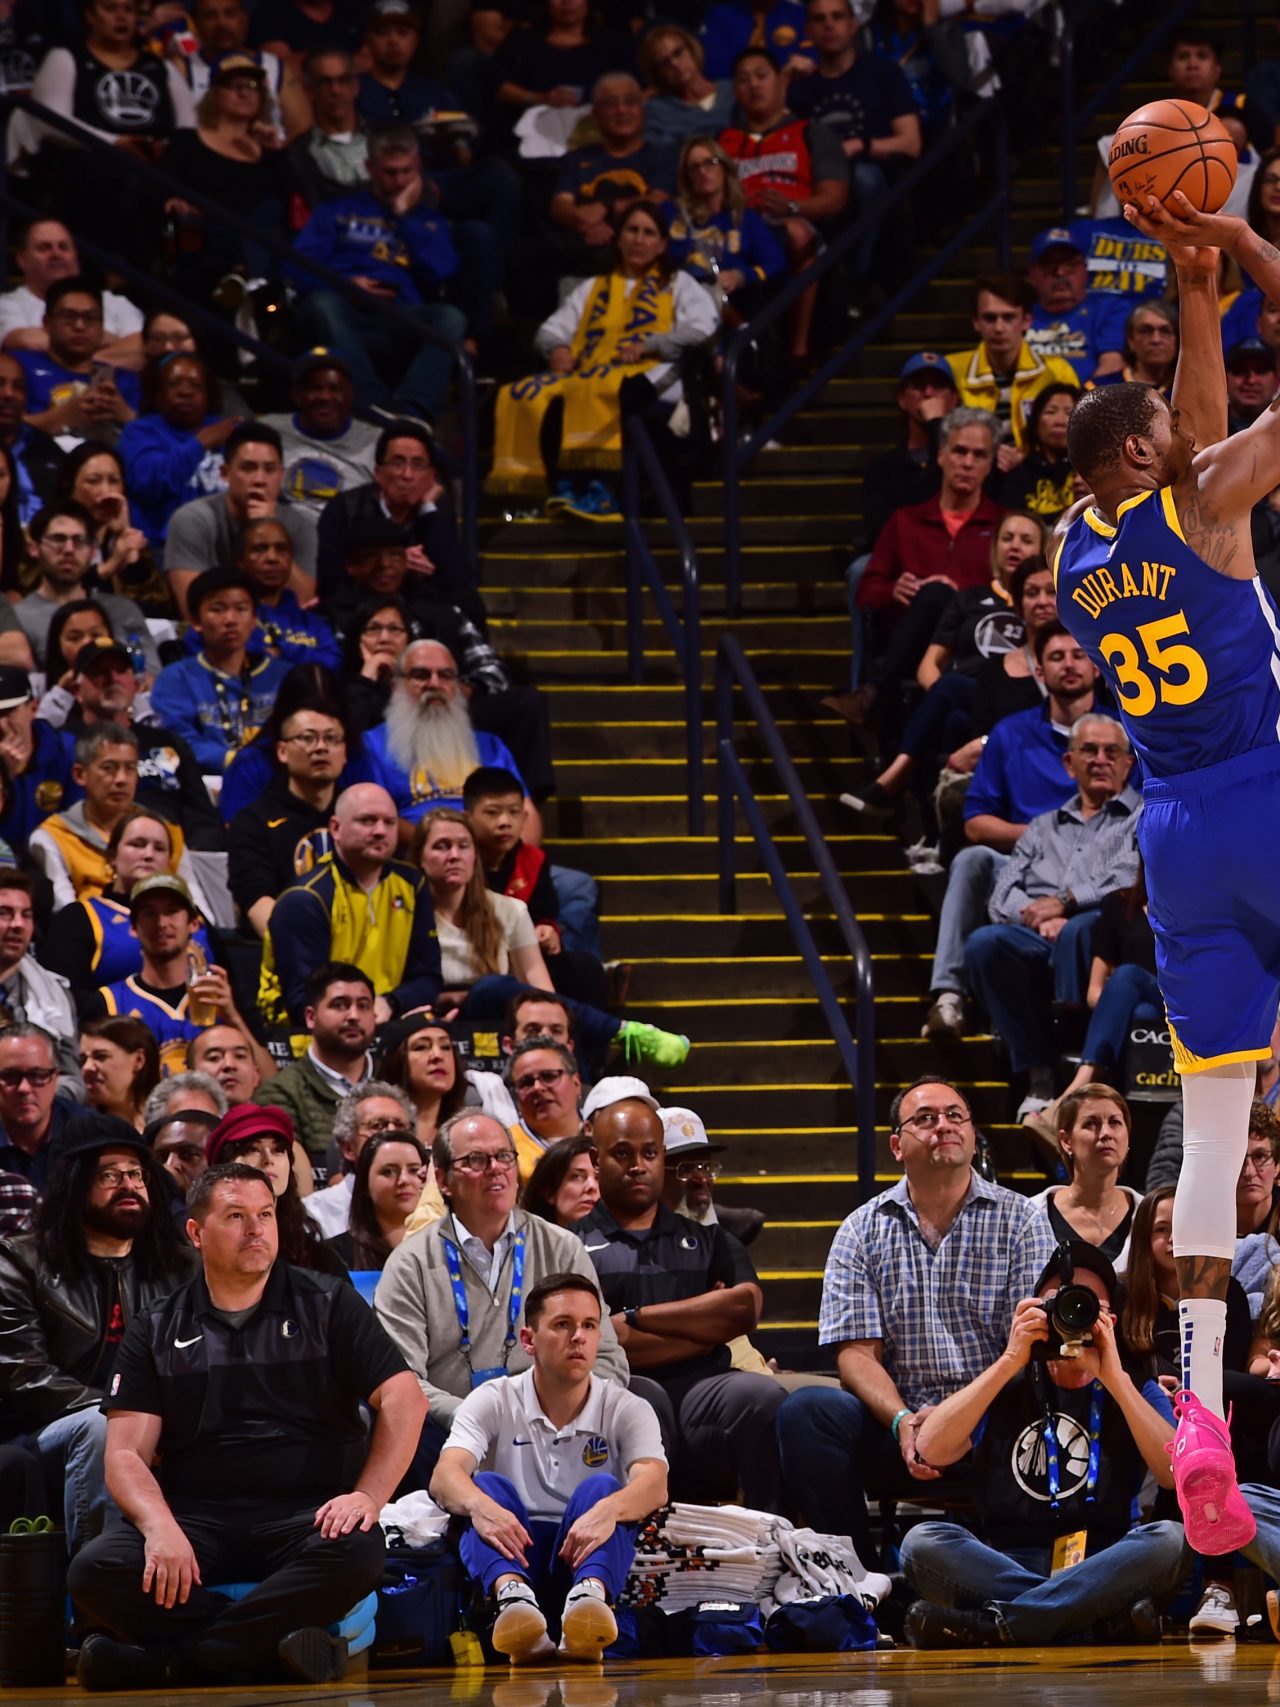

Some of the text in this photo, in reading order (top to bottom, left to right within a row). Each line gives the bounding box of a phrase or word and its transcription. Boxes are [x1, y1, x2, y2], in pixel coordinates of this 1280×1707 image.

[1072, 561, 1177, 620] DURANT
[1099, 609, 1209, 717] 35
[1135, 1070, 1183, 1090] cach
